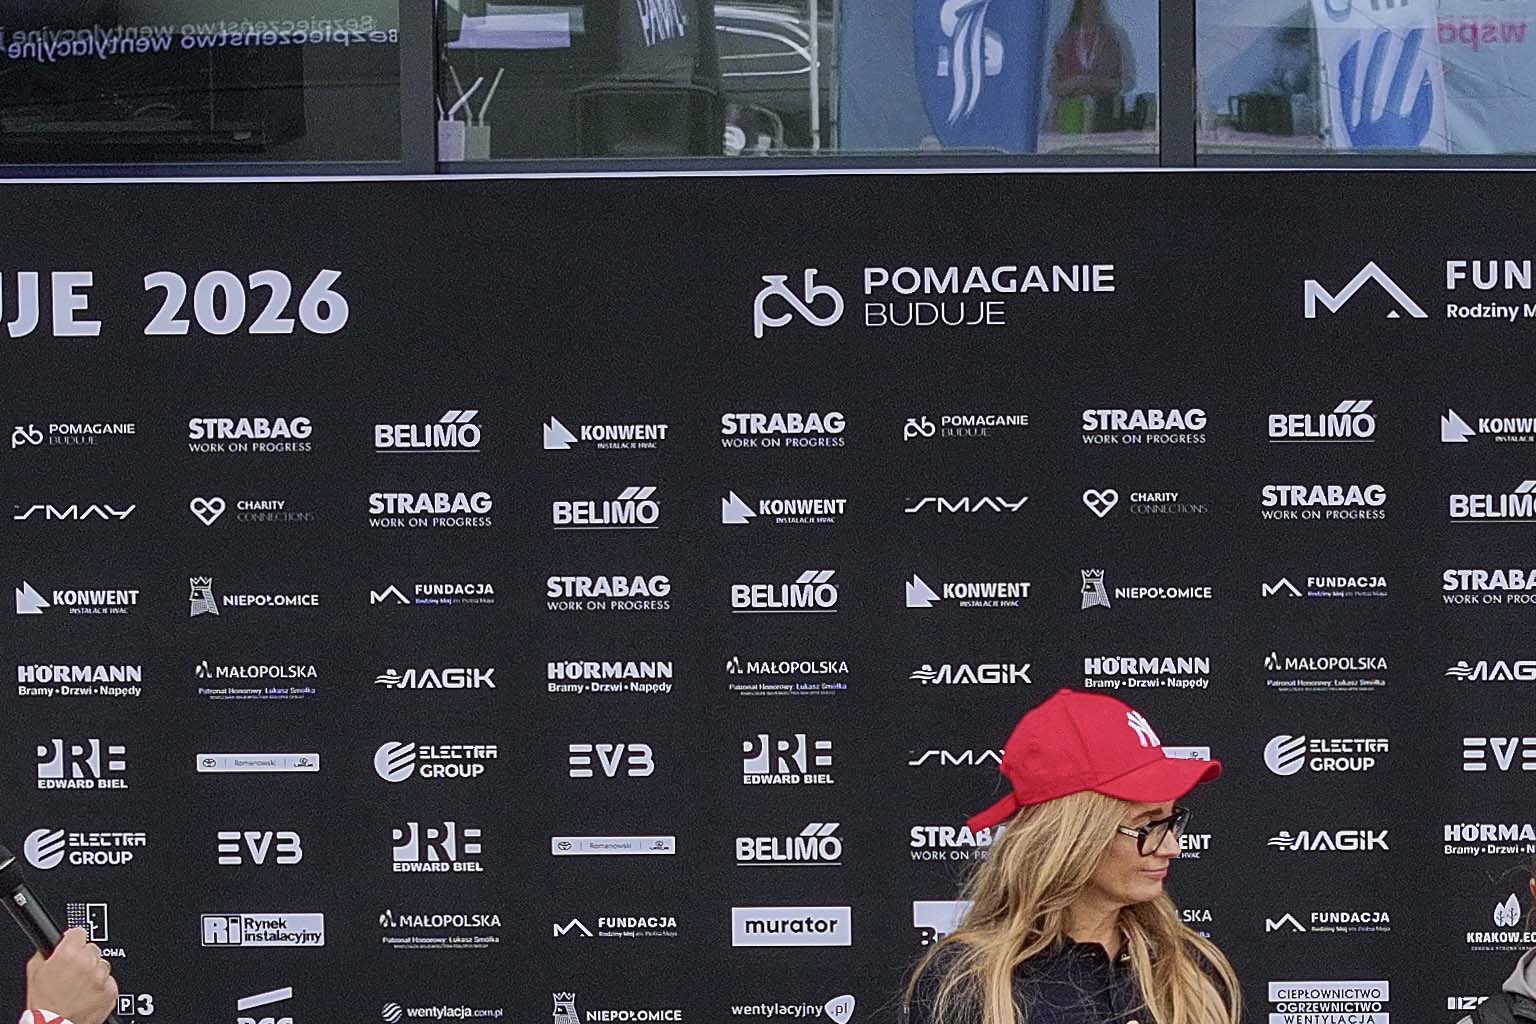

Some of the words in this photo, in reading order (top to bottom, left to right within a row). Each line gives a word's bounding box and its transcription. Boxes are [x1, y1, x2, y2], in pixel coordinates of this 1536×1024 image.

[864, 264, 1116, 295] POMAGANIE
[143, 268, 349, 336] 2026
[864, 301, 1006, 327] BUDUJE
[1446, 302, 1520, 323] Rodziny
[1082, 408, 1207, 431] STRABAG
[1268, 413, 1375, 438] BELIMO
[49, 423, 136, 435] POMAGANIE
[188, 416, 313, 440] STRABAG
[374, 423, 481, 448] BELIMO
[580, 424, 669, 441] KONWENT
[188, 442, 225, 453] WORK
[228, 442, 248, 453] ON
[252, 442, 312, 452] PROGRESS
[1261, 484, 1387, 507] STRABAG
[13, 504, 136, 520] SMAY
[236, 500, 285, 511] CHARITY
[415, 583, 495, 596] FUNDACJA
[1115, 586, 1212, 599] NIEPOŁOMICE
[52, 589, 140, 606] KONWENT
[223, 594, 320, 606] NIEPOŁOMICE
[17, 663, 142, 683] HÖRMANN
[215, 665, 318, 679] MAŁOPOLSKA
[746, 660, 849, 674] MAŁOPOLSKA
[419, 744, 498, 760] ELECTRA
[1309, 738, 1389, 753] ELECTRA
[419, 763, 485, 778] GROUP
[1309, 756, 1375, 772] GROUP
[37, 779, 95, 789] EDWARD
[97, 778, 129, 789] BIEL
[735, 836, 841, 861] BELIMO
[244, 917, 288, 931] Rynek
[745, 916, 838, 934] murator
[244, 929, 322, 943] instalacyjny
[1277, 988, 1381, 1000] CIEPŁOWNICTWO
[406, 1005, 503, 1020] wentylacja.com.pl
[1275, 1002, 1382, 1014] OGRZEWNICTWO
[1279, 1012, 1376, 1024] WENTYLACJA
